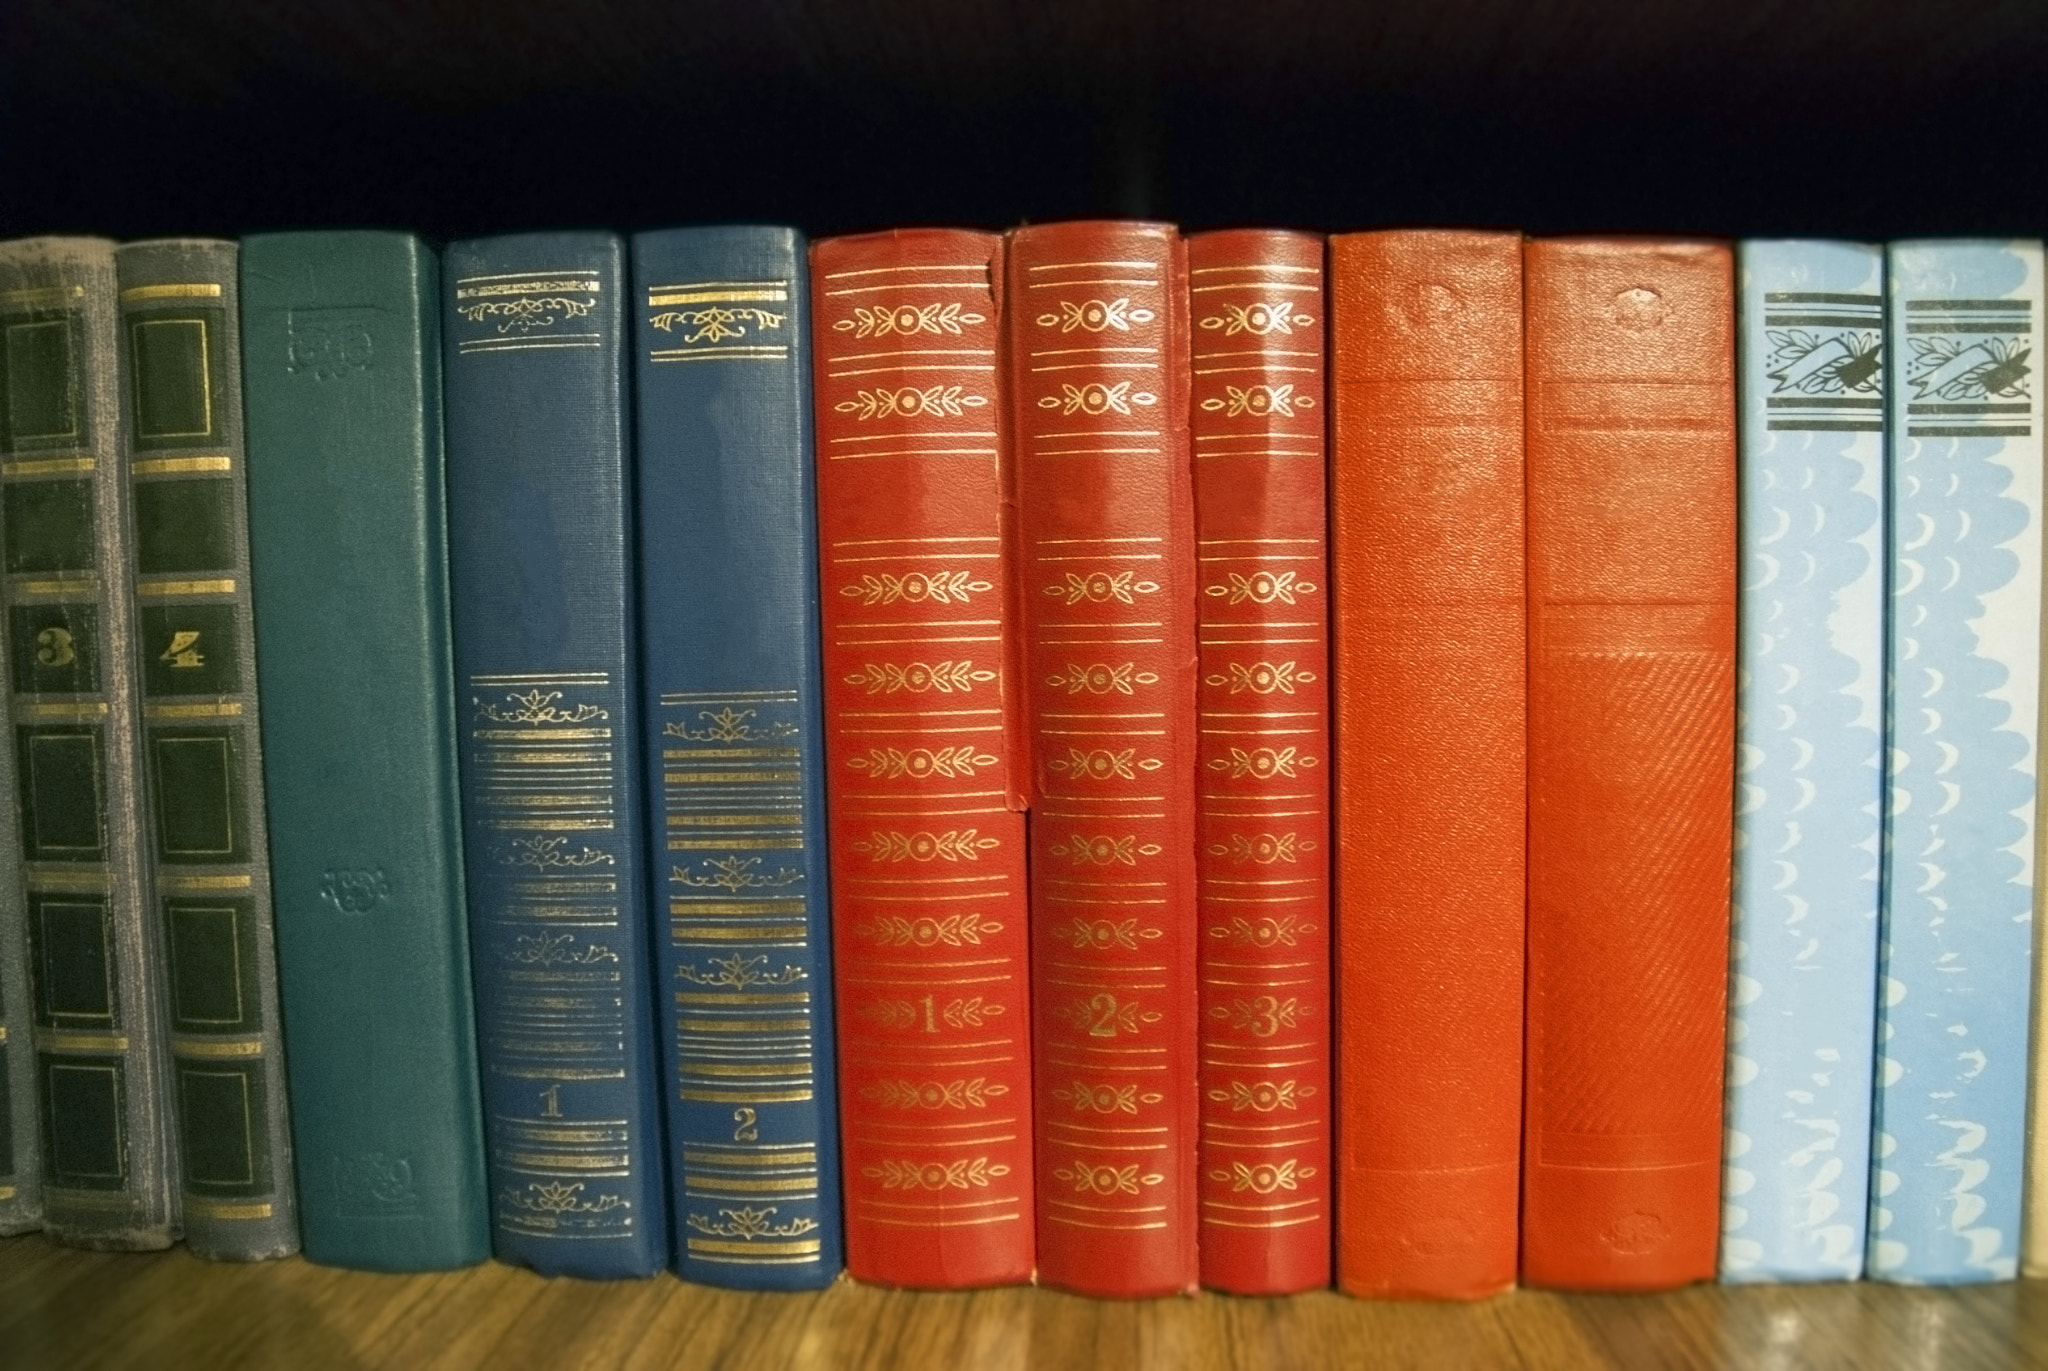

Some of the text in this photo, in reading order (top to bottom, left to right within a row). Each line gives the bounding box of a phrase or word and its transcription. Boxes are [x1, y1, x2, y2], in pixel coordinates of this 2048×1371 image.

[37, 627, 75, 667] 3
[159, 631, 204, 667] 4
[917, 996, 939, 1033] 1
[1089, 994, 1117, 1036] 2
[1251, 996, 1279, 1036] 3
[539, 1084, 564, 1117] 1
[733, 1108, 758, 1141] 2
